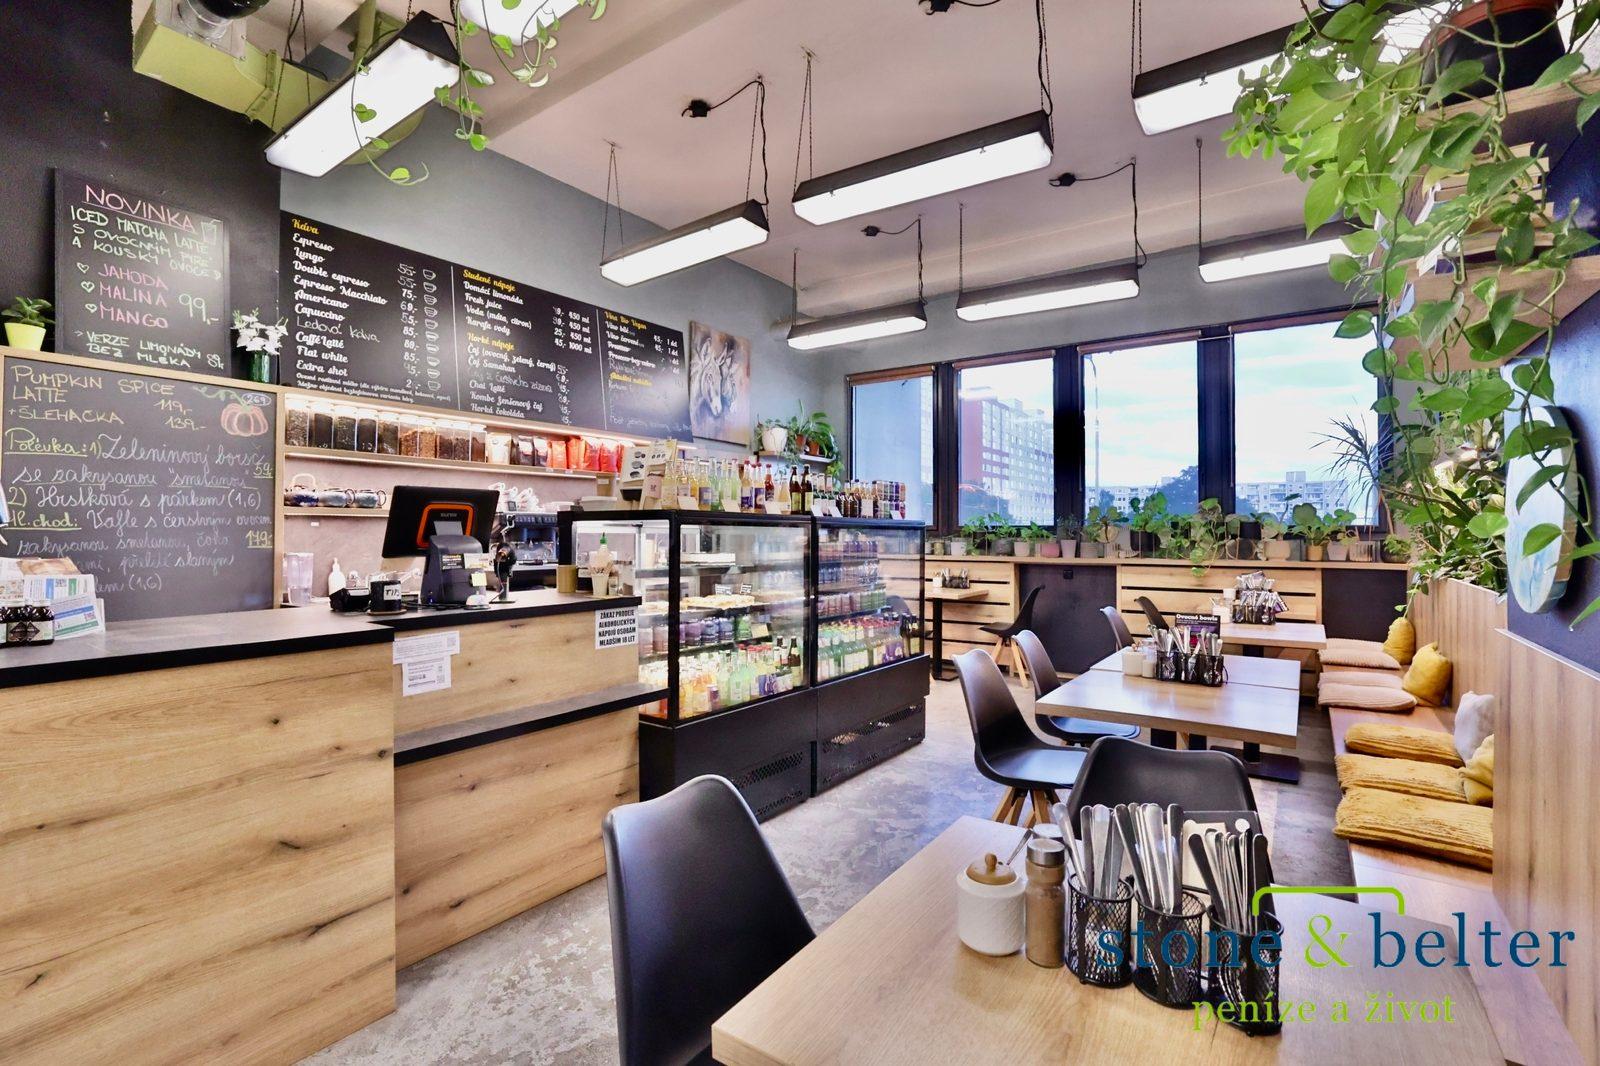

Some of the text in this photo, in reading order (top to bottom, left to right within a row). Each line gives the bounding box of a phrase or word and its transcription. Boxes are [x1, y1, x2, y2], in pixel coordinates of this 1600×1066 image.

[85, 184, 197, 232] NOVINKA
[71, 205, 208, 255] ICED MATCHA LATTE
[73, 223, 85, 234] S
[291, 218, 320, 235] Káva
[293, 233, 335, 252] Espresso
[72, 236, 208, 277] A KOUSKY OVOCE
[293, 247, 325, 264] Lungo
[98, 264, 168, 290] JAHODA
[293, 260, 328, 278] Double
[331, 273, 370, 288] espresso
[463, 269, 516, 292] Studené nápoje
[100, 282, 167, 308] MALINA
[293, 275, 336, 293] Espresso
[339, 286, 388, 305] Macchiato
[294, 290, 349, 309] Americano
[463, 280, 490, 295] Domácí
[492, 289, 524, 305] limonáda
[465, 293, 484, 305] Fresh
[485, 298, 503, 310] juice
[465, 303, 485, 316] Voda
[100, 302, 168, 329] MANGO
[294, 303, 345, 322] Capuccino
[296, 316, 342, 335] Ledová
[466, 316, 492, 331] Karafa
[494, 325, 511, 336] vody
[87, 331, 129, 346] VERZE
[296, 331, 320, 346] Caffé
[467, 332, 515, 351] Horké nápoje
[88, 344, 123, 358] BEZ
[297, 346, 318, 358] Flat
[322, 351, 348, 363] white
[468, 343, 480, 355] Čaj
[296, 360, 348, 376] Extra shot
[468, 355, 480, 368] Čaj
[11, 365, 175, 396] PUMPKIN SPICE
[12, 385, 68, 403] LATTE
[470, 403, 493, 414] Horká
[8, 486, 27, 507] 2)
[139, 494, 151, 507] s
[144, 515, 157, 528] s
[600, 609, 634, 619] ZÁKAZ PRODEJE
